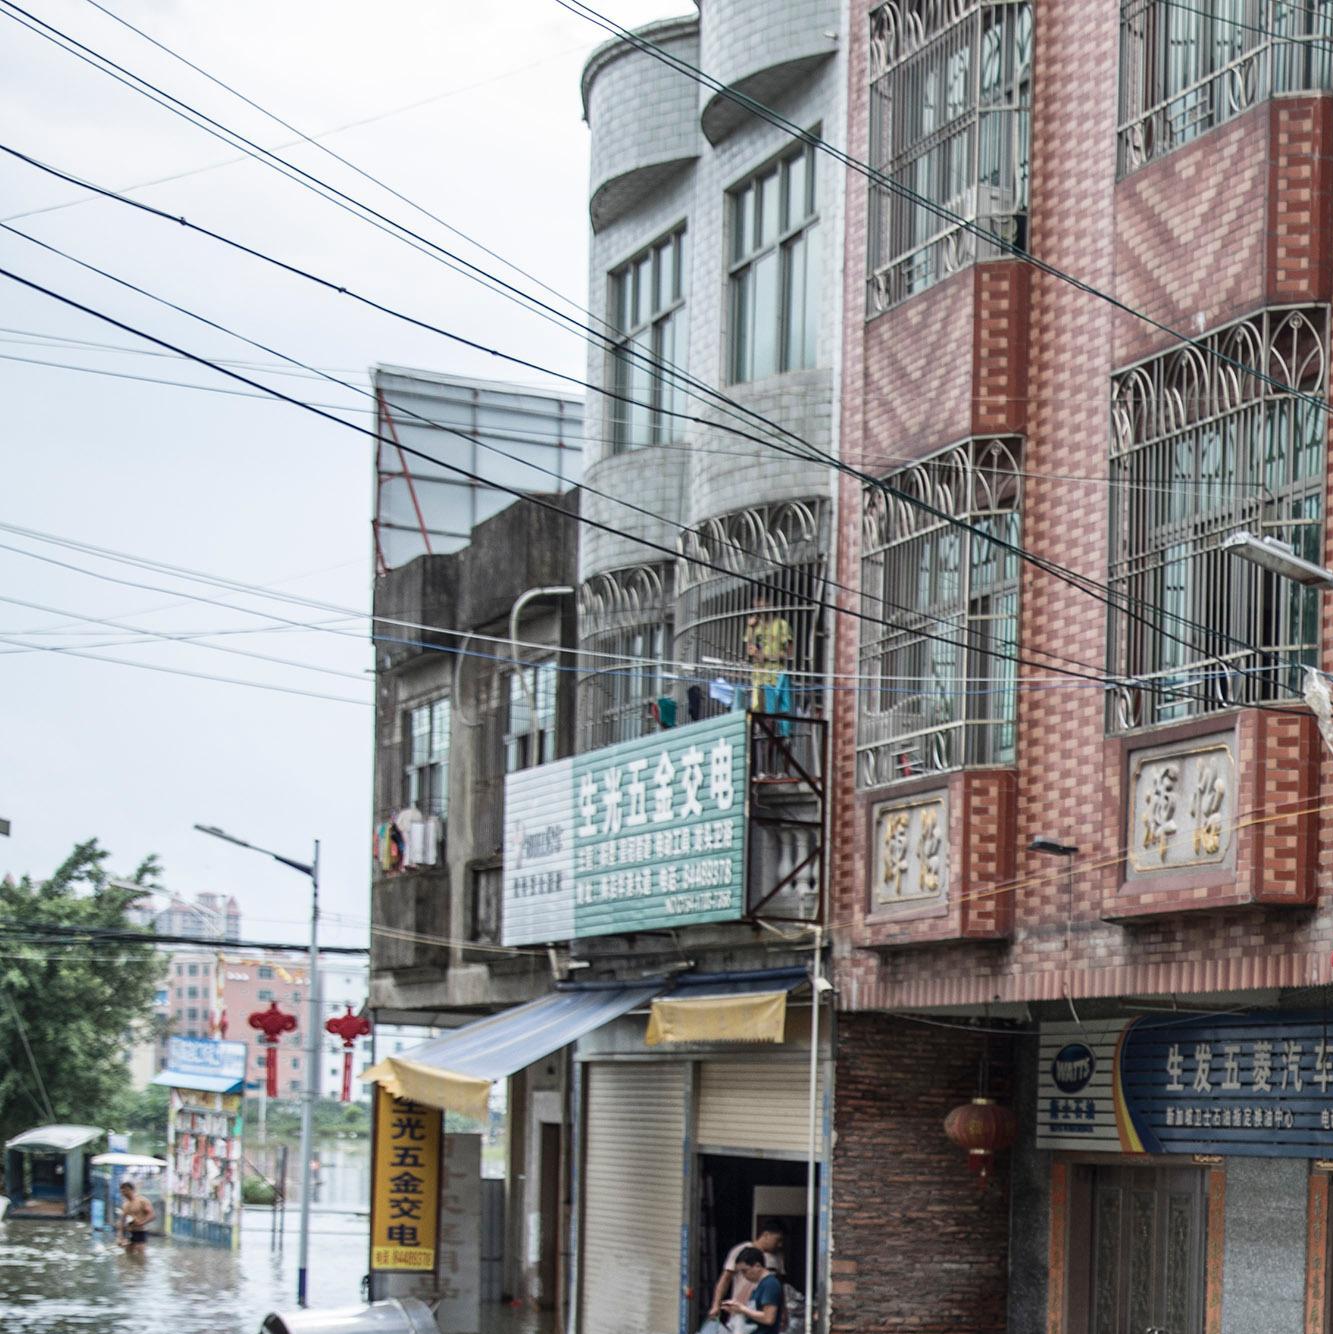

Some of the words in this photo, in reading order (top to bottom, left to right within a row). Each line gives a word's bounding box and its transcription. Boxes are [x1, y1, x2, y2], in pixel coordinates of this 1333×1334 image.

[578, 736, 733, 838] 生光五金交电
